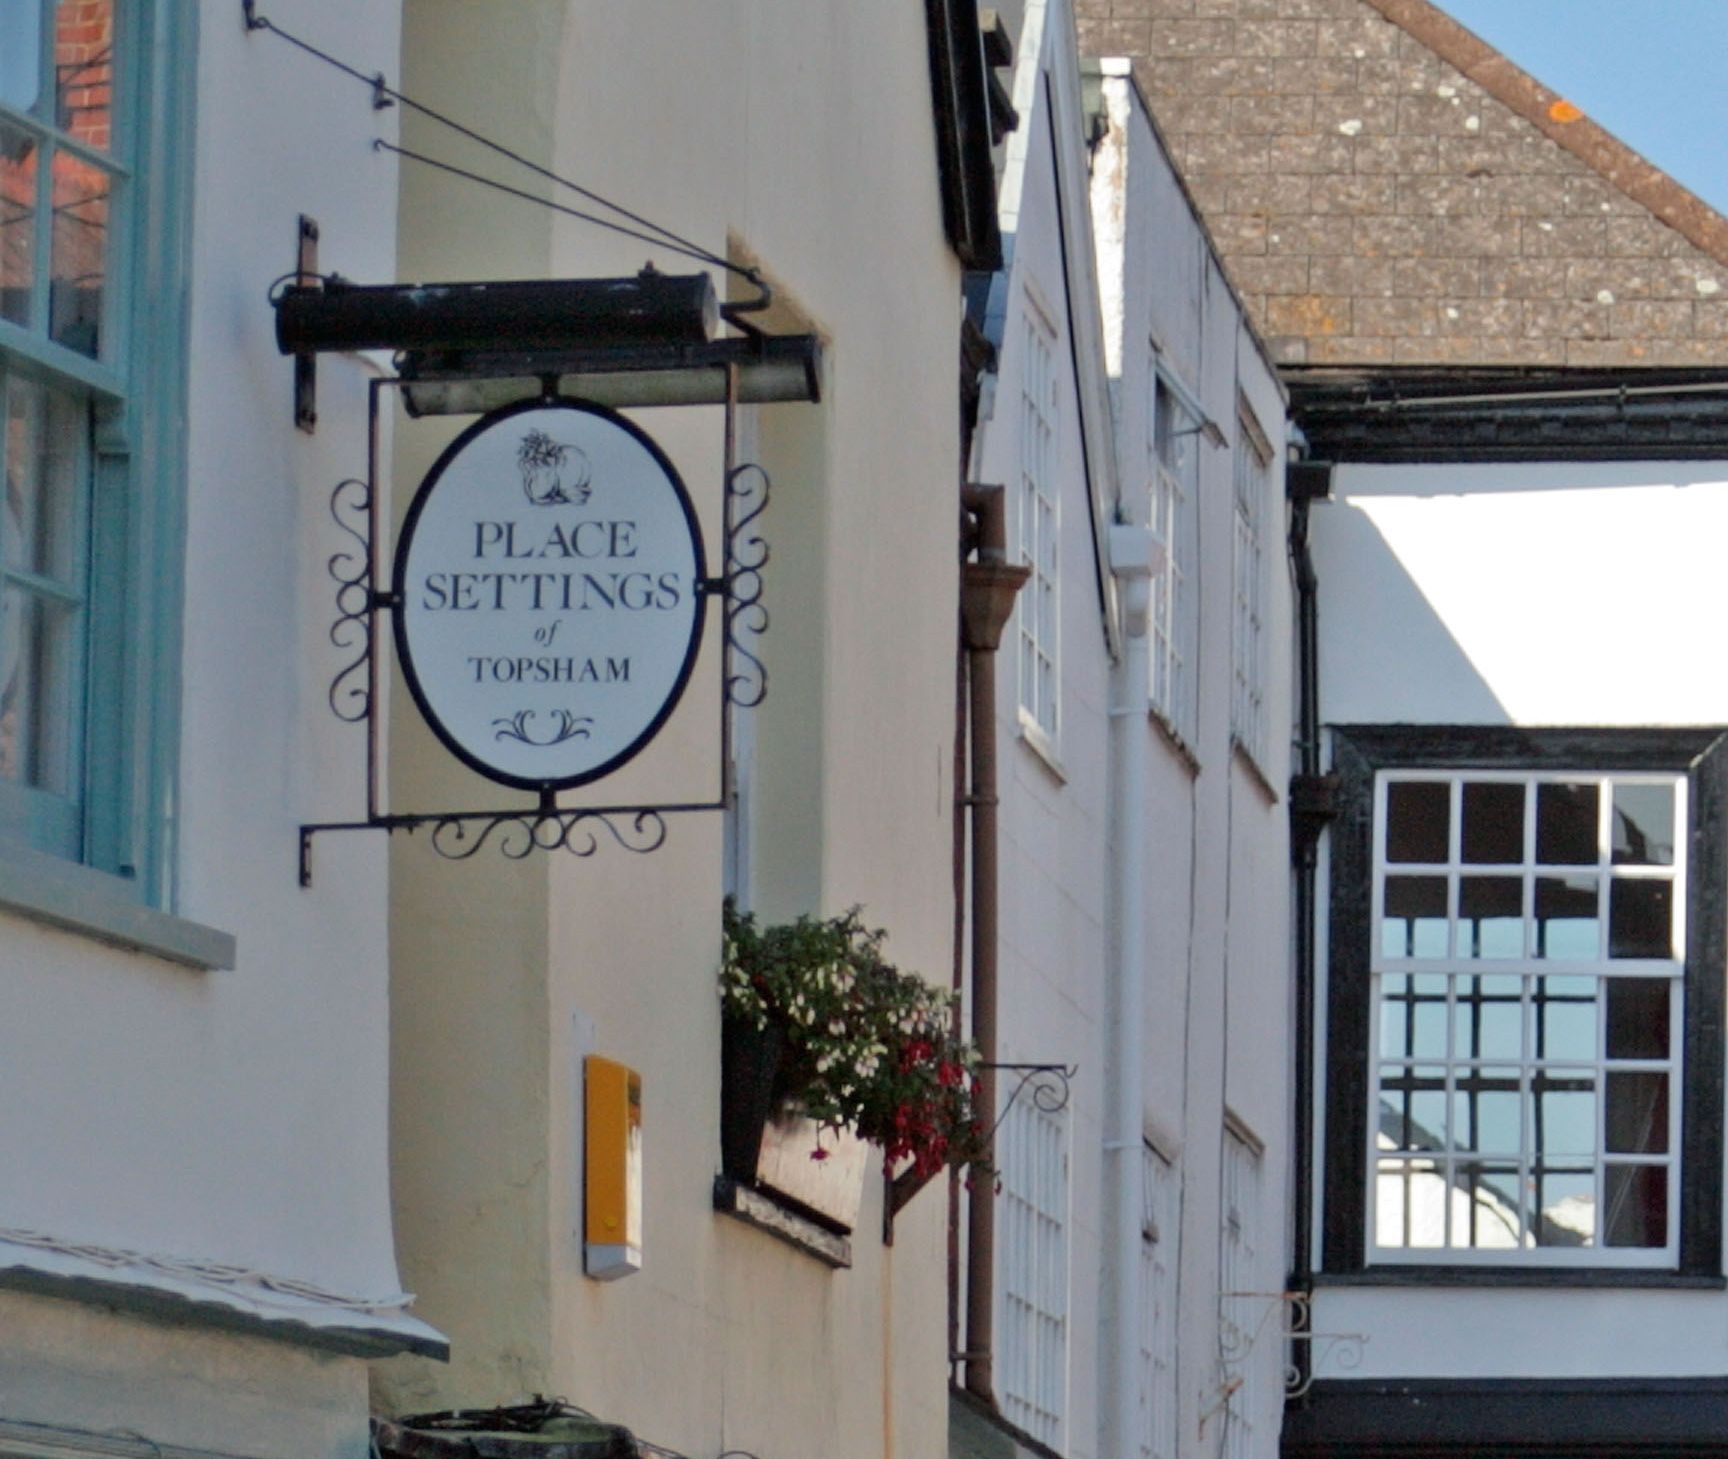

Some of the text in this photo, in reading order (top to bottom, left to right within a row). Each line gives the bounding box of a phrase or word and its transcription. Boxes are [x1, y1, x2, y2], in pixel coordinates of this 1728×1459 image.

[473, 521, 638, 559] PLACE
[422, 572, 680, 611] SETTINGS
[534, 619, 563, 647] of
[467, 657, 631, 683] TOPSHAM
